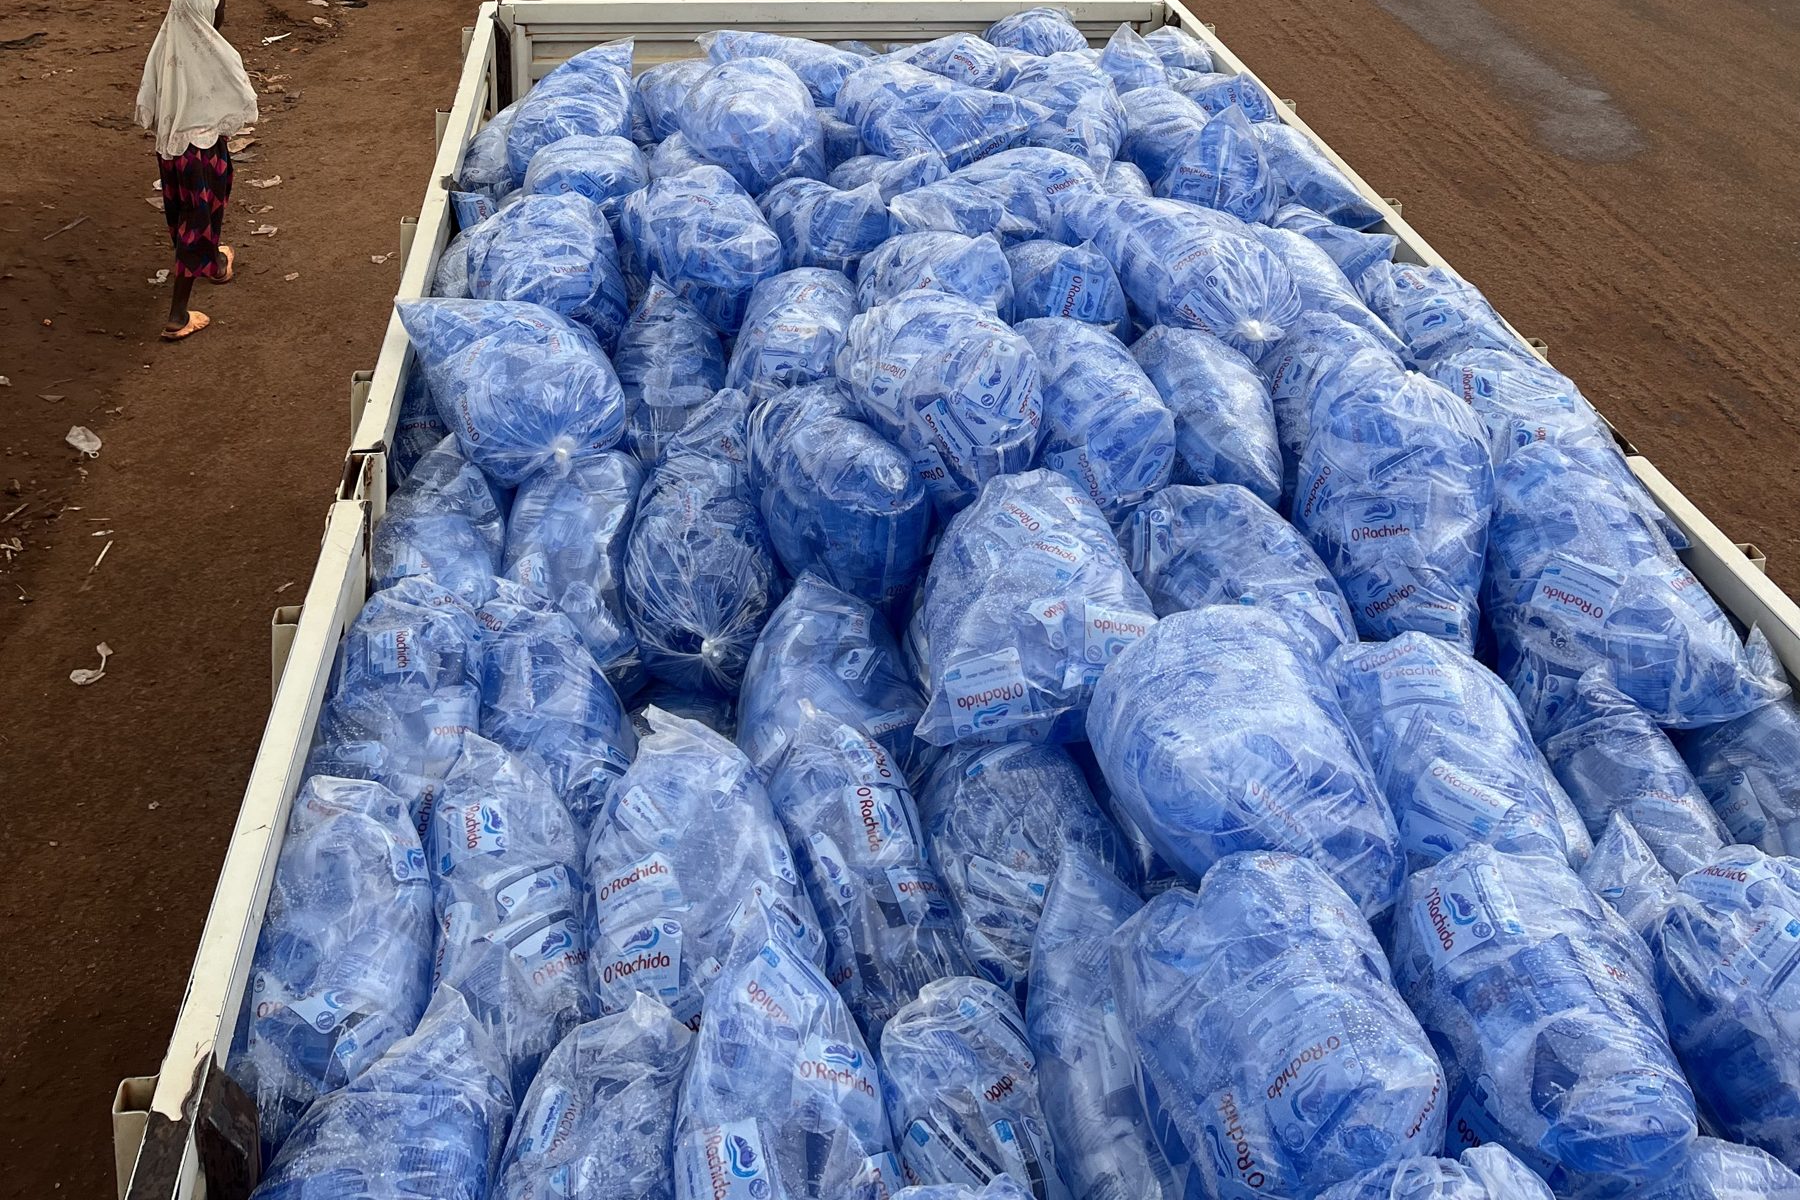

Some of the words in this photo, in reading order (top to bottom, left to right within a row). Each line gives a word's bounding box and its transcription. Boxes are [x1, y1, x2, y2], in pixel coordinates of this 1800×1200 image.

[402, 419, 437, 431] O'Rach
[1304, 465, 1332, 519] O'Rachida
[1352, 524, 1410, 542] O'Rachida
[1033, 541, 1077, 563] 'Rachida
[1365, 584, 1416, 619] O'Rachida
[1543, 585, 1604, 619] O'Rachida
[1094, 618, 1145, 636] Rachida
[396, 631, 411, 669] Rachida
[957, 683, 1024, 709] O'Rachida
[417, 784, 434, 837] achida
[857, 787, 883, 854] O'Rachida
[600, 860, 669, 902] O'Rachida
[899, 881, 945, 898] achida
[603, 952, 670, 984] O'Rachida
[800, 1060, 875, 1098] O'Rachida
[1266, 1035, 1341, 1100] O'Rachida
[1221, 1090, 1265, 1189] O'Rachida
